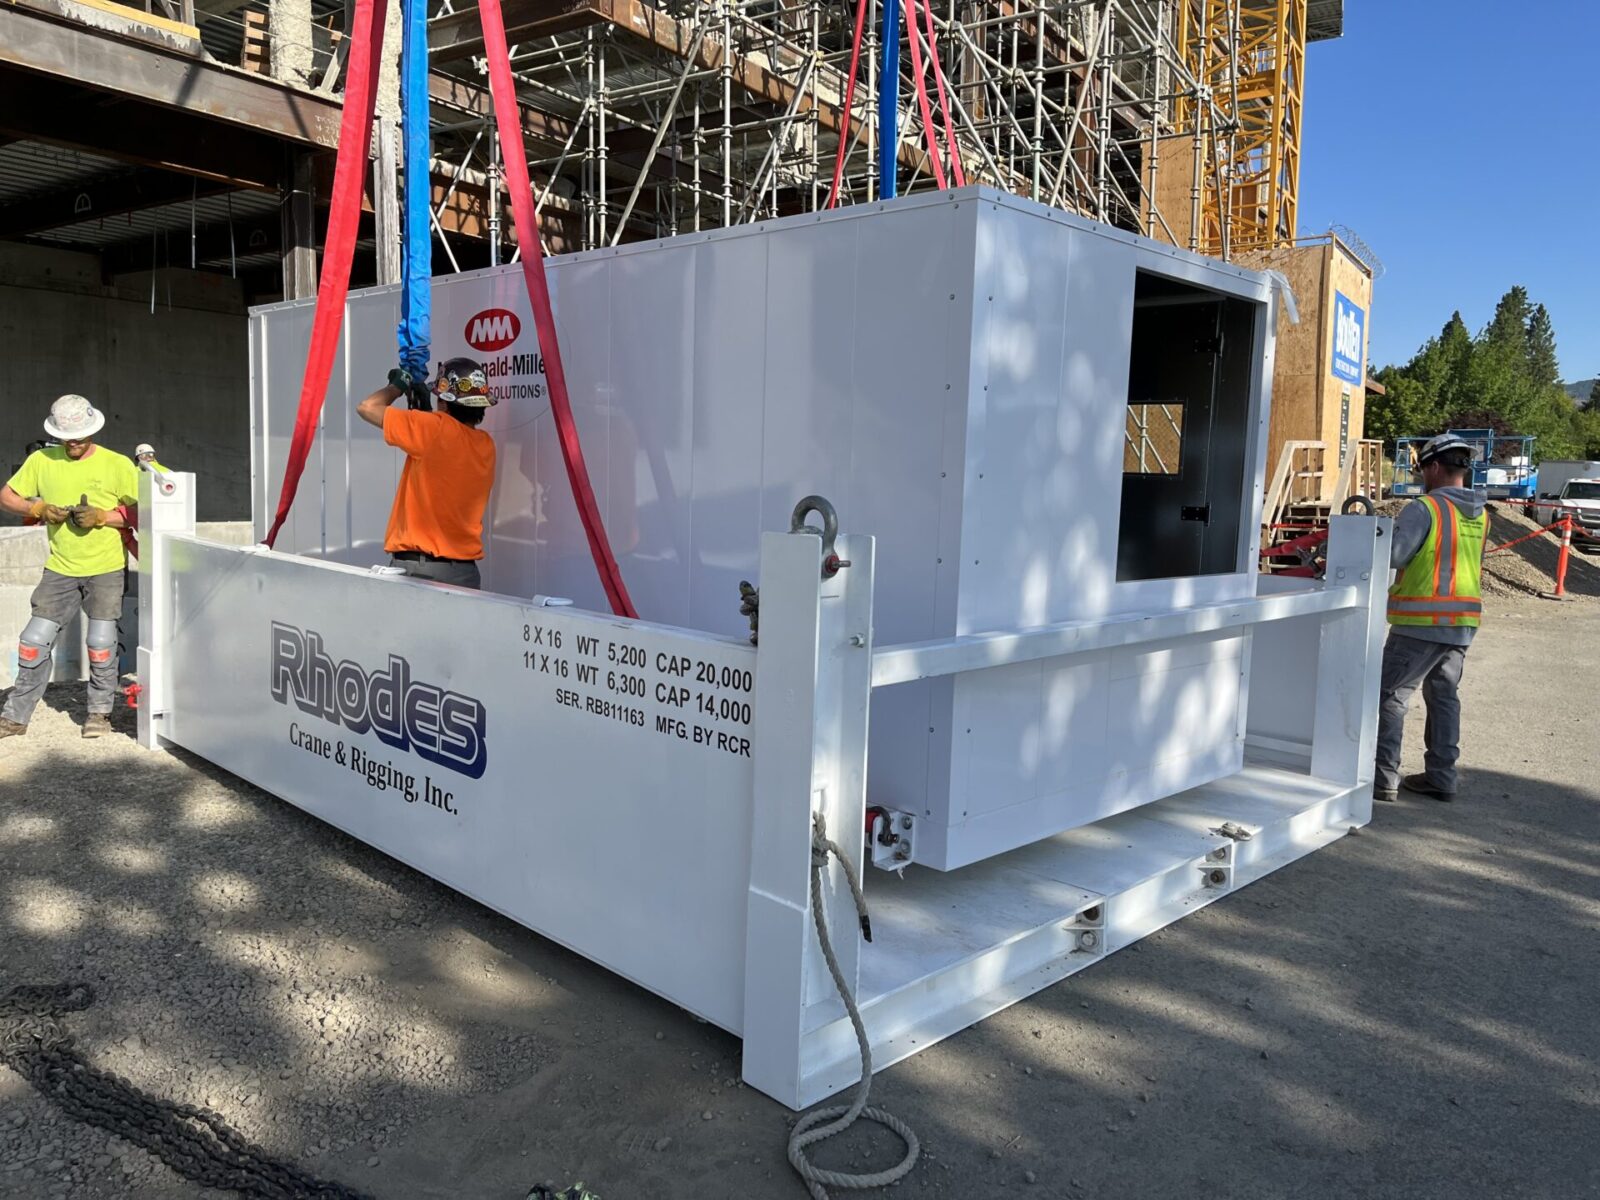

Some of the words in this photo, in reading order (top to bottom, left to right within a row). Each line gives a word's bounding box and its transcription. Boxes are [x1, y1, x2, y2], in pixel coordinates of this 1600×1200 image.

[480, 353, 546, 378] nald-Mille
[523, 624, 530, 642] 8
[534, 626, 543, 645] X
[547, 628, 562, 649] 16
[576, 634, 599, 658] WT
[608, 642, 646, 669] 5,200
[656, 652, 691, 678] CAP
[696, 660, 753, 693] 20,000
[523, 651, 536, 670] 11
[540, 654, 549, 674] X
[553, 657, 569, 679] 16
[576, 663, 599, 686] WT
[607, 671, 646, 698] 6,300
[655, 682, 690, 709] CAP
[696, 692, 751, 725] 14,000
[556, 688, 583, 710] SER.
[586, 696, 645, 727] RB811163
[656, 715, 688, 741] MFG.
[693, 725, 714, 746] BY
[717, 731, 751, 758] RCR
[289, 722, 331, 759] Crane
[335, 740, 347, 766] &
[351, 746, 419, 803] Rigging,
[425, 776, 458, 815] Inc.
